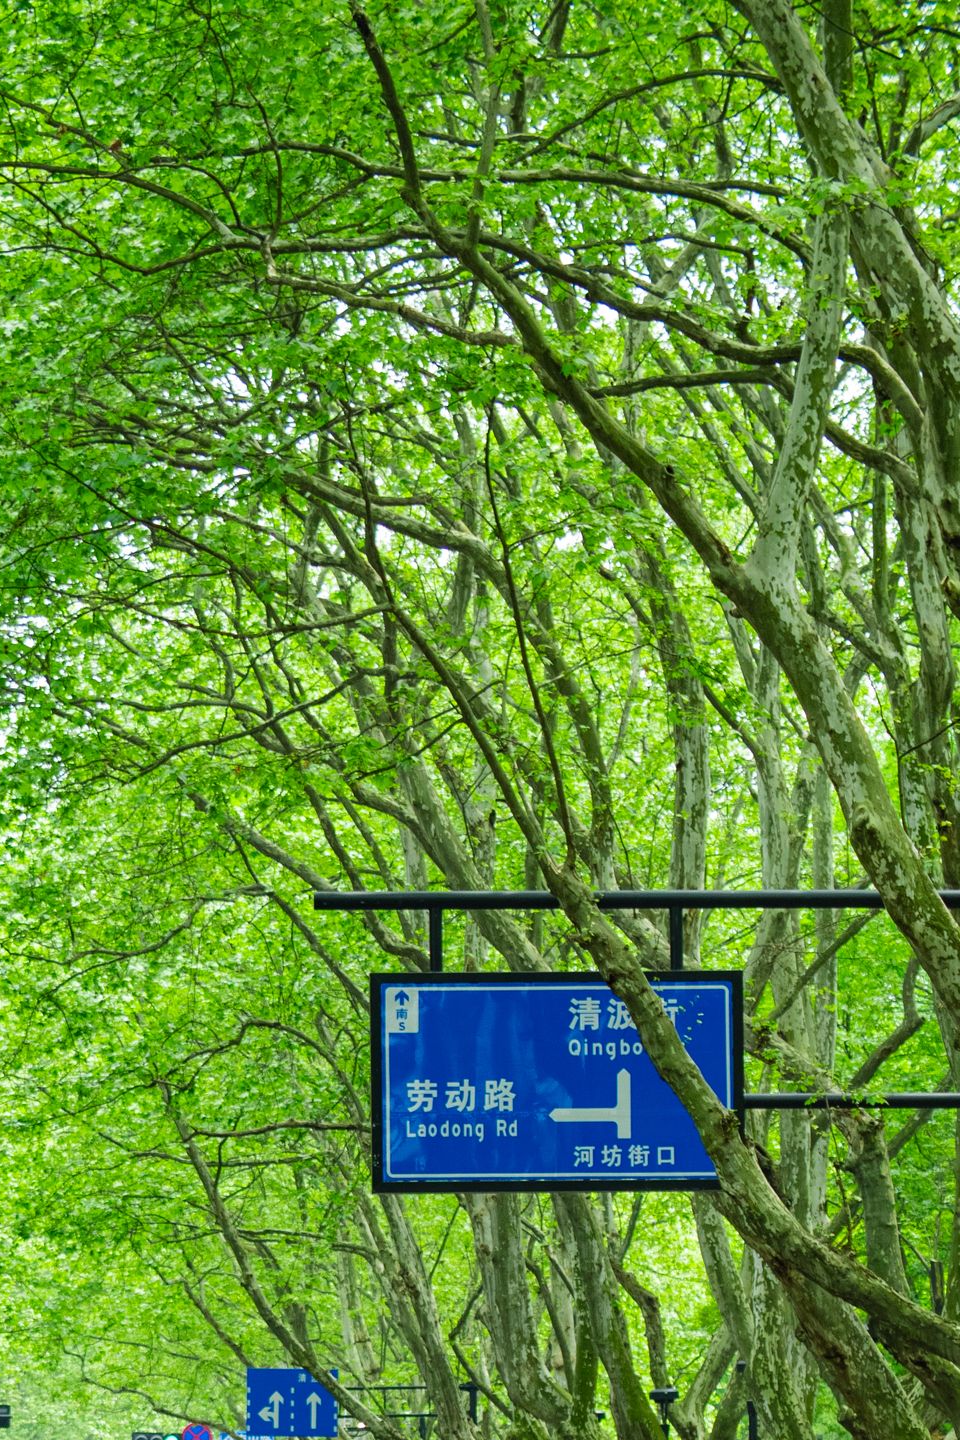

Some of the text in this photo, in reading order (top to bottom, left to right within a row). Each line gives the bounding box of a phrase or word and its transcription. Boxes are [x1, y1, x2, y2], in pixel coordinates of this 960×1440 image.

[395, 1008, 408, 1020] 南
[398, 1021, 406, 1031] S
[406, 1078, 516, 1112] 劳动路
[406, 1119, 518, 1142] Laodong Rd
[573, 1144, 675, 1168] 河坊街口
